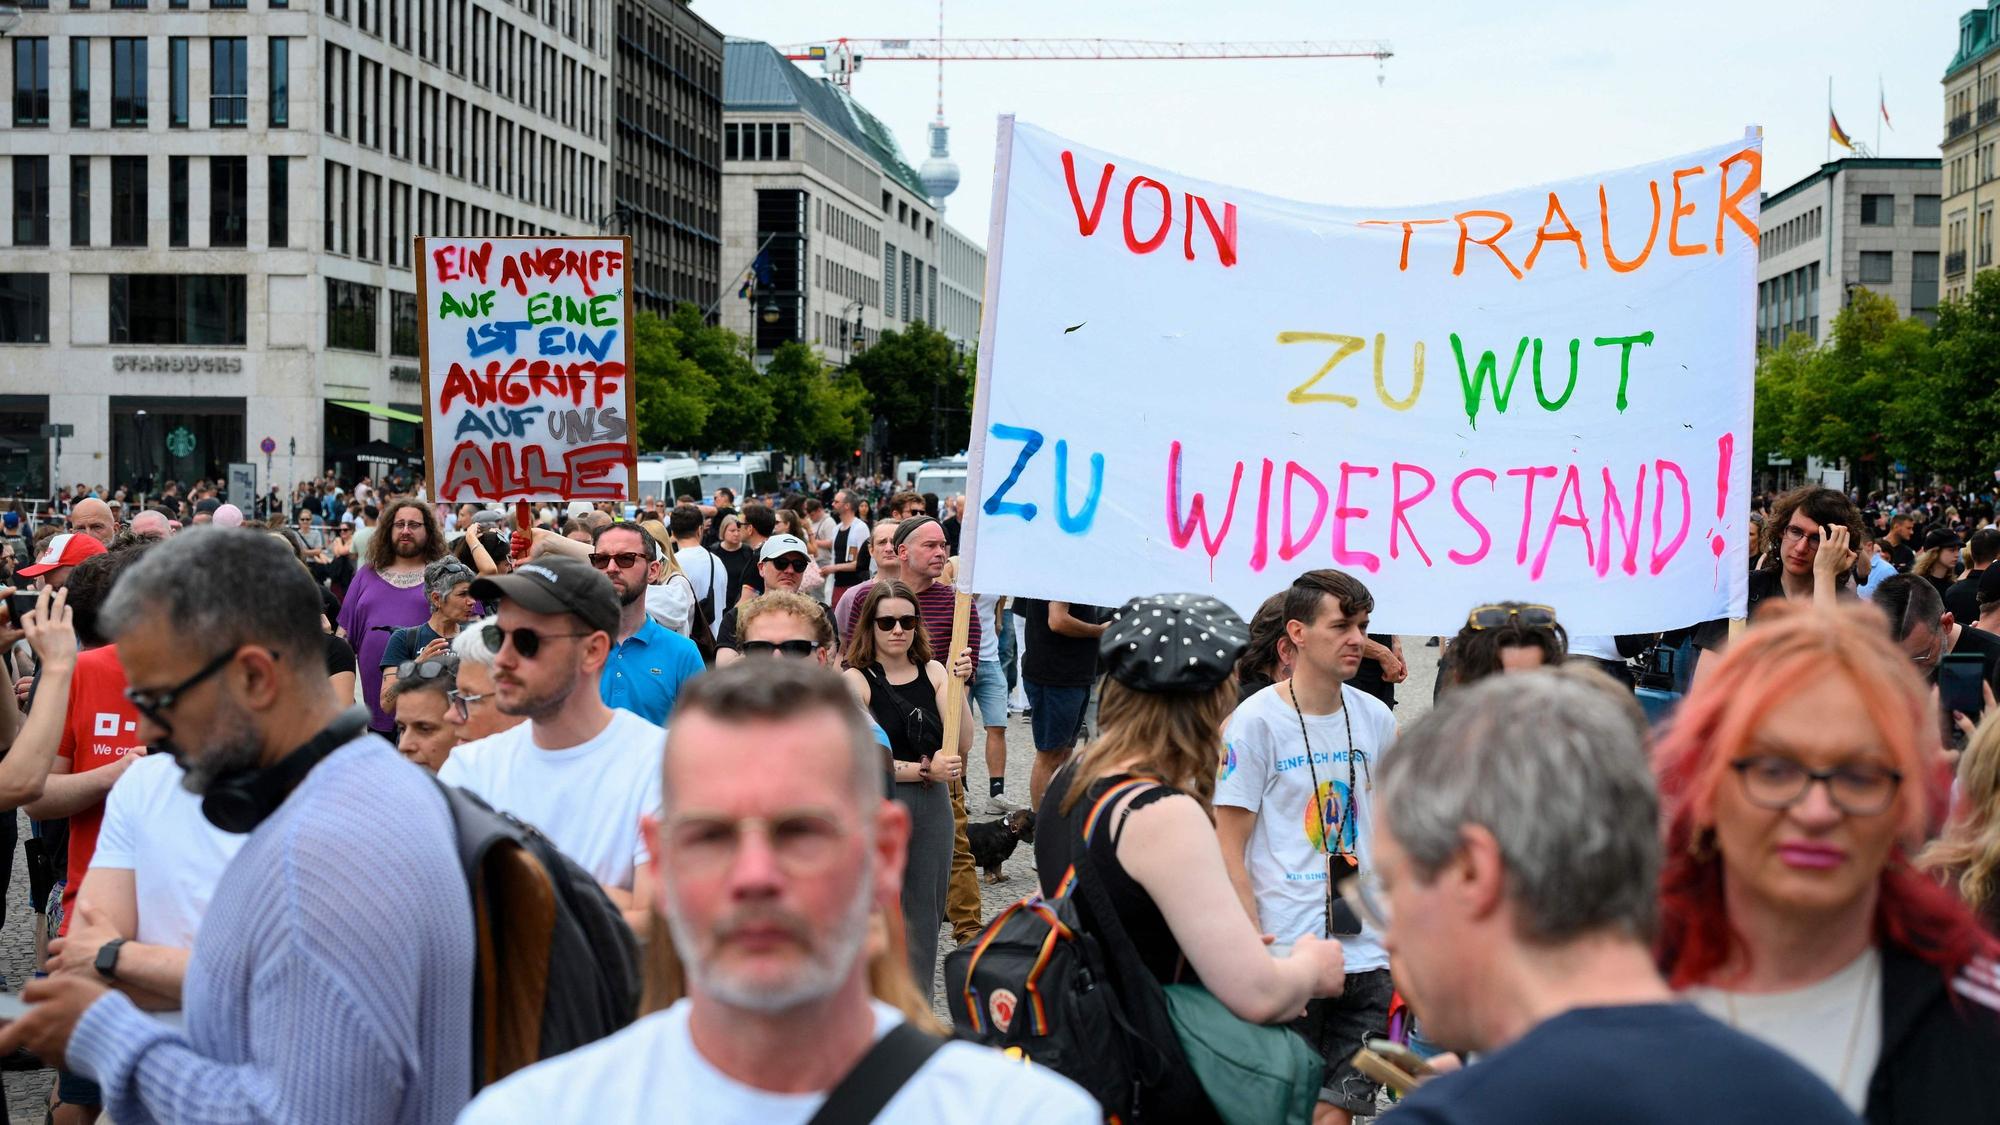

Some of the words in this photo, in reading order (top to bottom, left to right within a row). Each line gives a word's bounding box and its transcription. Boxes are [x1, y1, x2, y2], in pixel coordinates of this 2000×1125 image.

[1061, 150, 1237, 267] VON
[1358, 148, 1762, 279] TRAUER
[433, 242, 493, 284] EIN
[501, 247, 623, 297] ANGRIFF
[440, 289, 496, 319] AUF
[466, 321, 533, 358] IST
[538, 326, 617, 362] EIN
[440, 358, 626, 416] ANGRIFF
[1277, 331, 1425, 409] ZU
[1450, 331, 1655, 429] WUT
[455, 405, 543, 440] AUF
[547, 406, 627, 444] UNS
[440, 440, 637, 501] ALLE
[983, 423, 1105, 536] ZU
[1167, 433, 1734, 582] WIDERSTAND!
[93, 744, 111, 756] We
[1276, 751, 1329, 772] EINFACH
